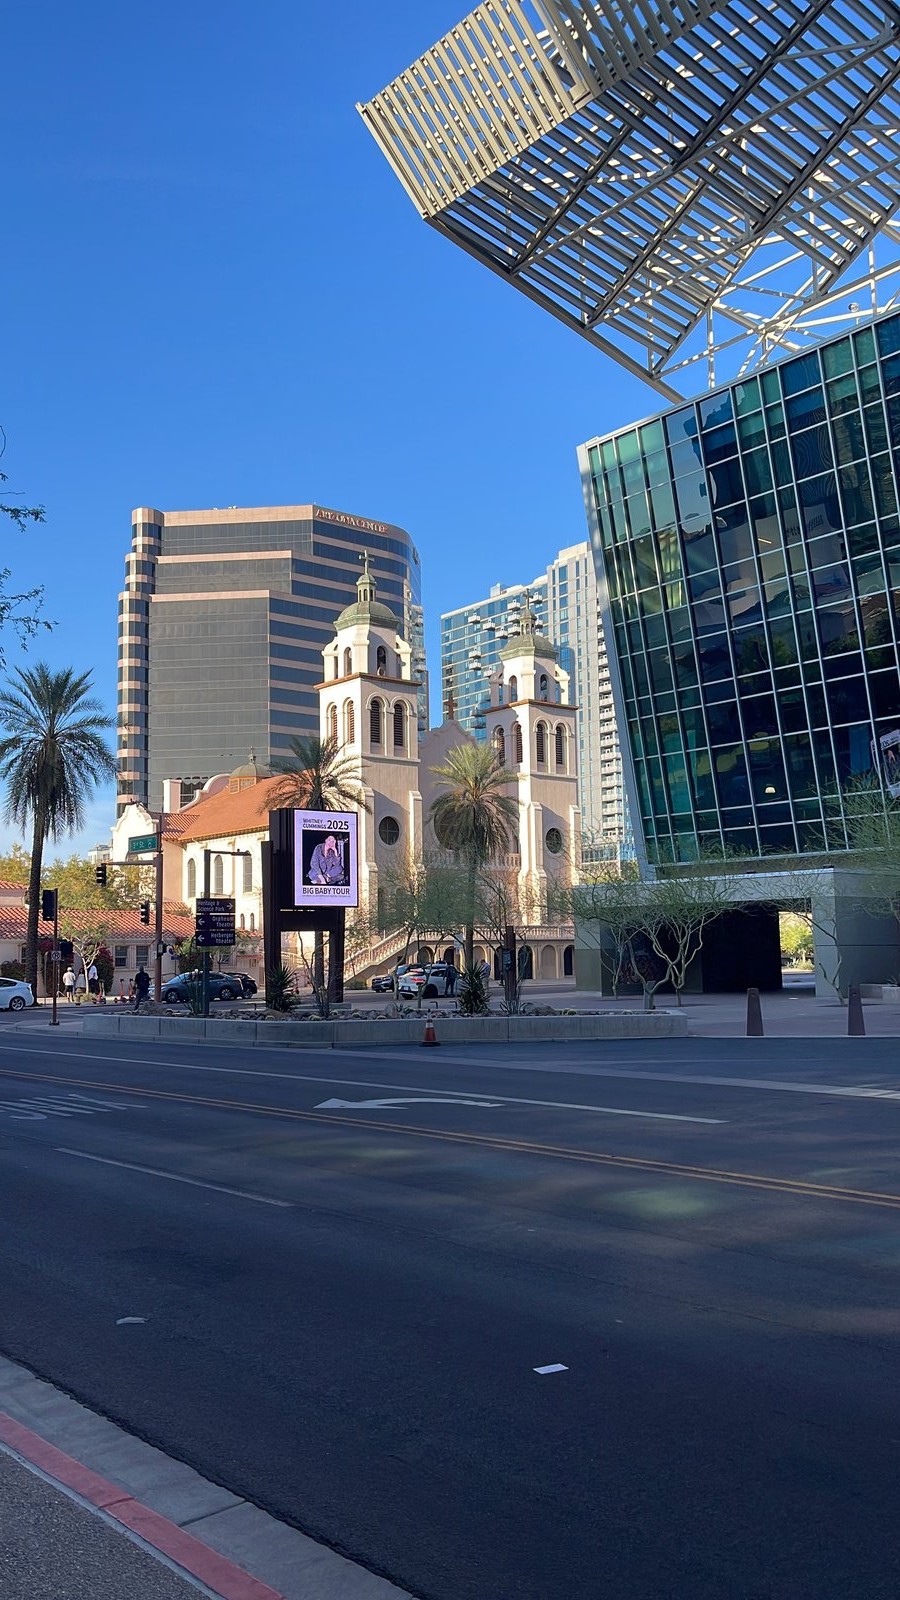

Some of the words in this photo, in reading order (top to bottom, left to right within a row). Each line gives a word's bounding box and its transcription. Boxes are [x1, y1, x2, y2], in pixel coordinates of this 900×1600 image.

[316, 509, 355, 525] ARIZONA
[327, 820, 349, 830] 2025
[332, 887, 350, 895] TOUR
